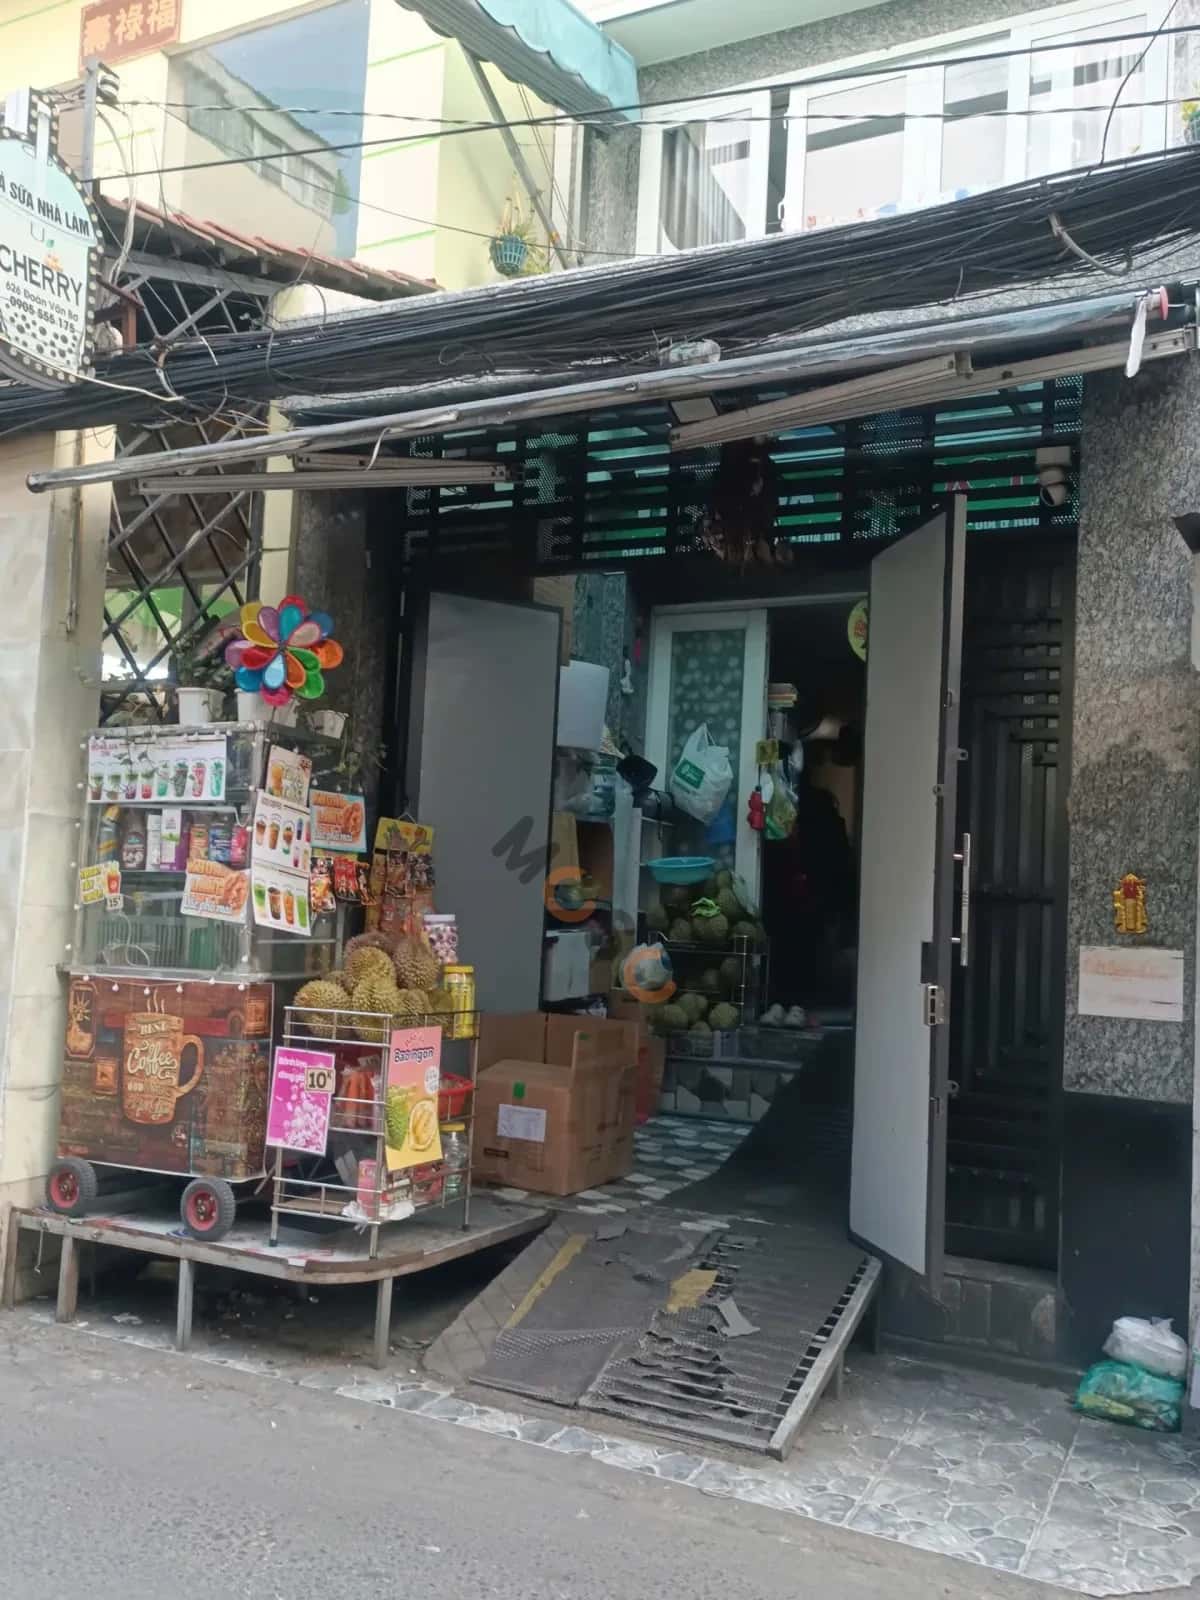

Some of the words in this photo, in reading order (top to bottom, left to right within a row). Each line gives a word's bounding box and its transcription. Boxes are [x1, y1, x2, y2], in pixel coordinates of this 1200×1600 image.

[65, 210, 90, 237] LÀM
[0, 244, 82, 306] CHERRY
[127, 1039, 178, 1079] Coffee
